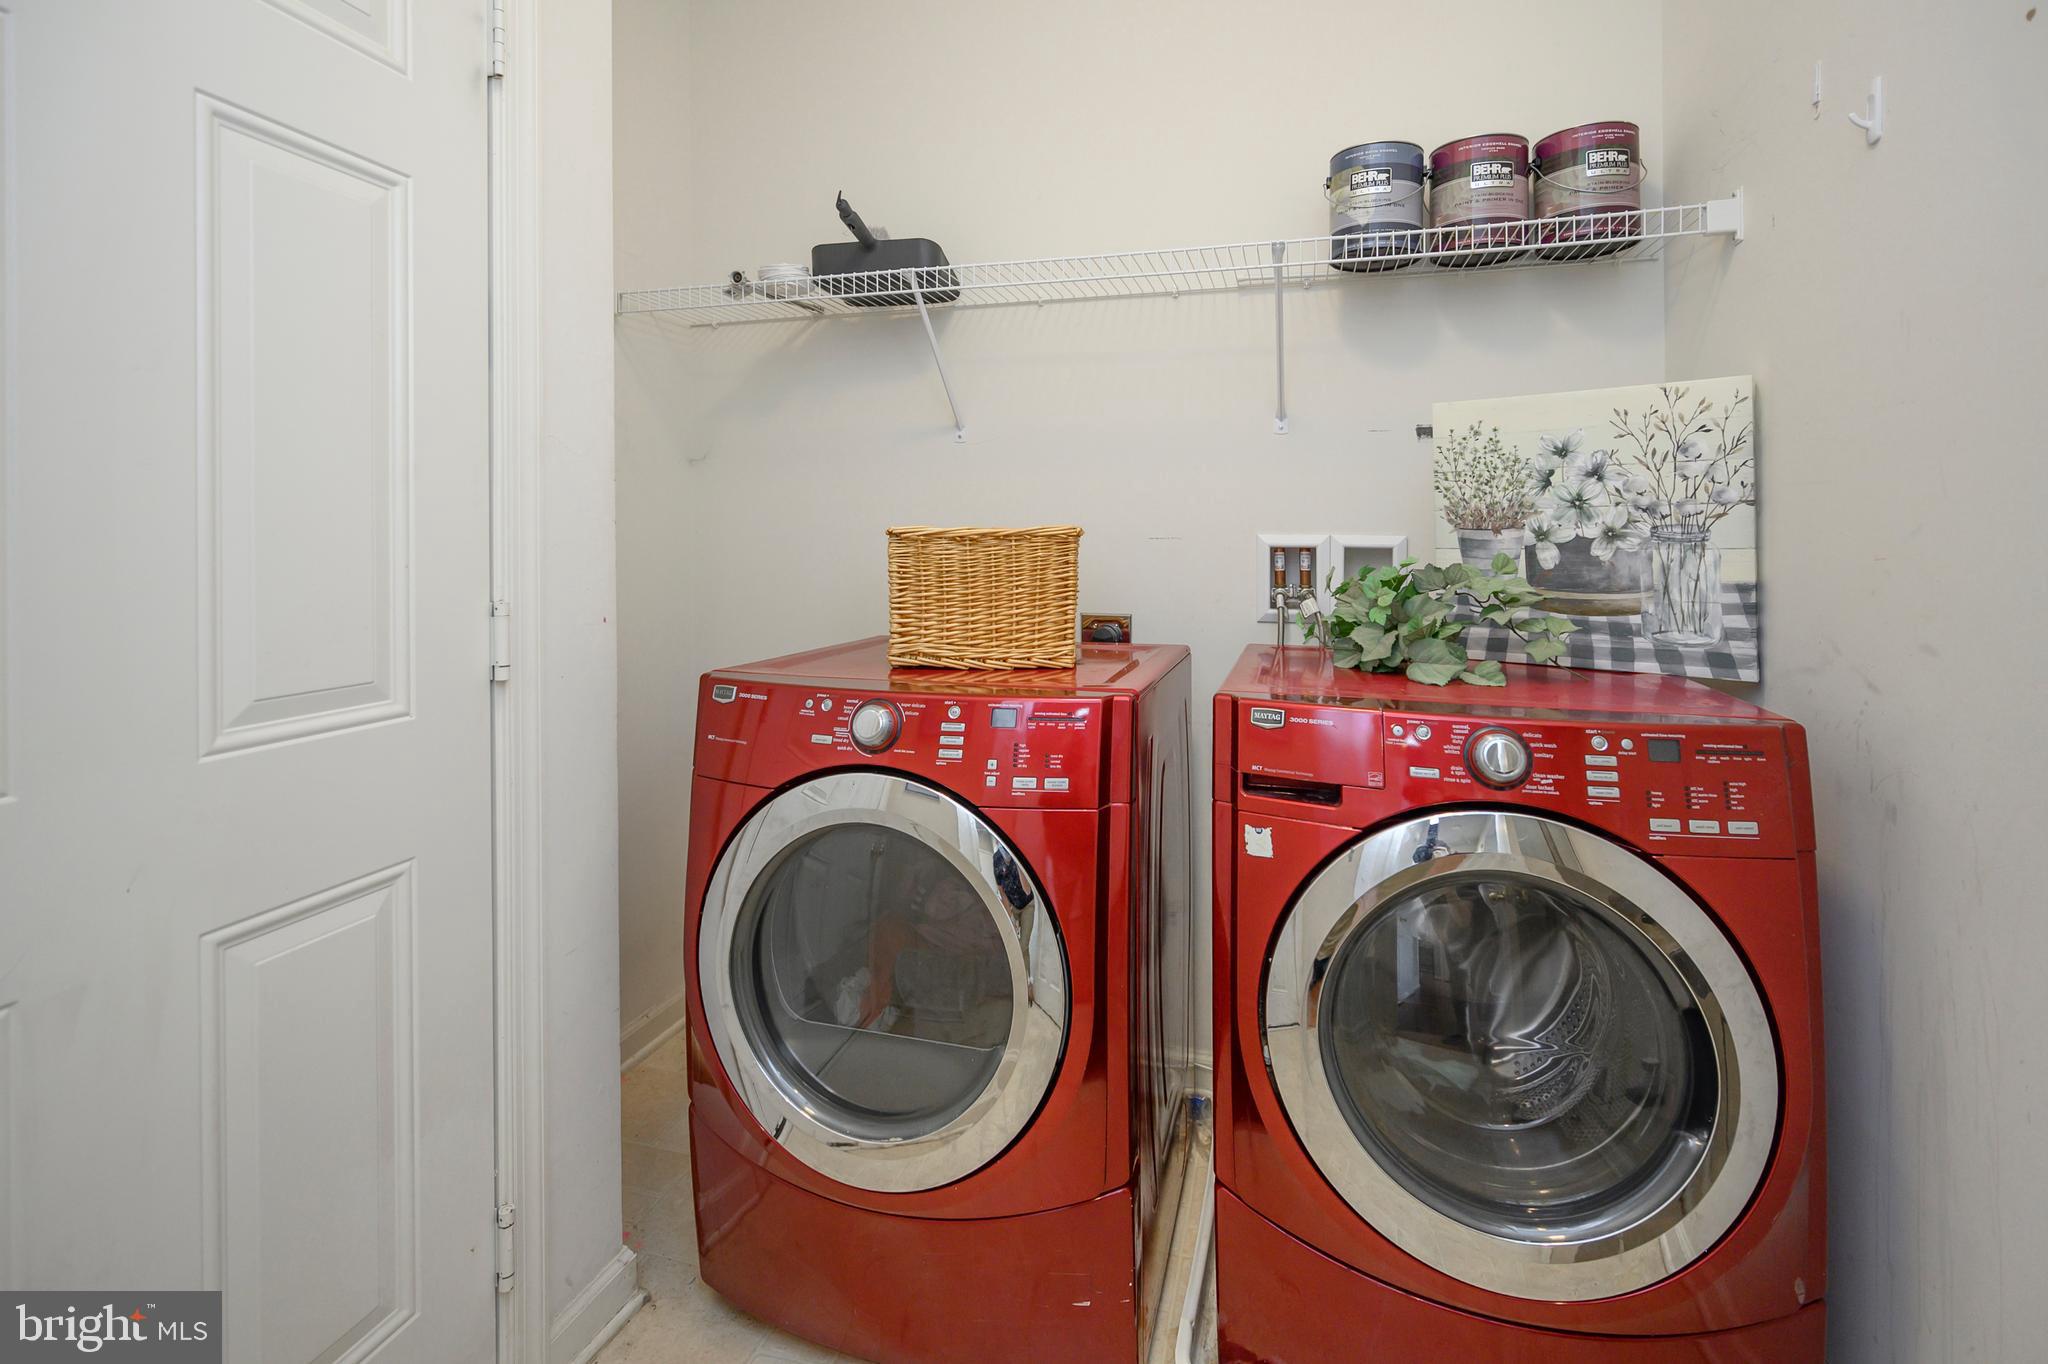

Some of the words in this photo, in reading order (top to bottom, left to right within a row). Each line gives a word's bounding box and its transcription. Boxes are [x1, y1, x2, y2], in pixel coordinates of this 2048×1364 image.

[1588, 150, 1618, 163] BEHR
[1473, 163, 1502, 176] BEHR
[1352, 170, 1378, 184] BEHR
[1351, 181, 1375, 189] PREMIUM
[1376, 178, 1389, 186] PLUS
[1254, 712, 1281, 721] MAYTAG
[1289, 716, 1308, 724] 3000
[1308, 718, 1335, 726] SERIES
